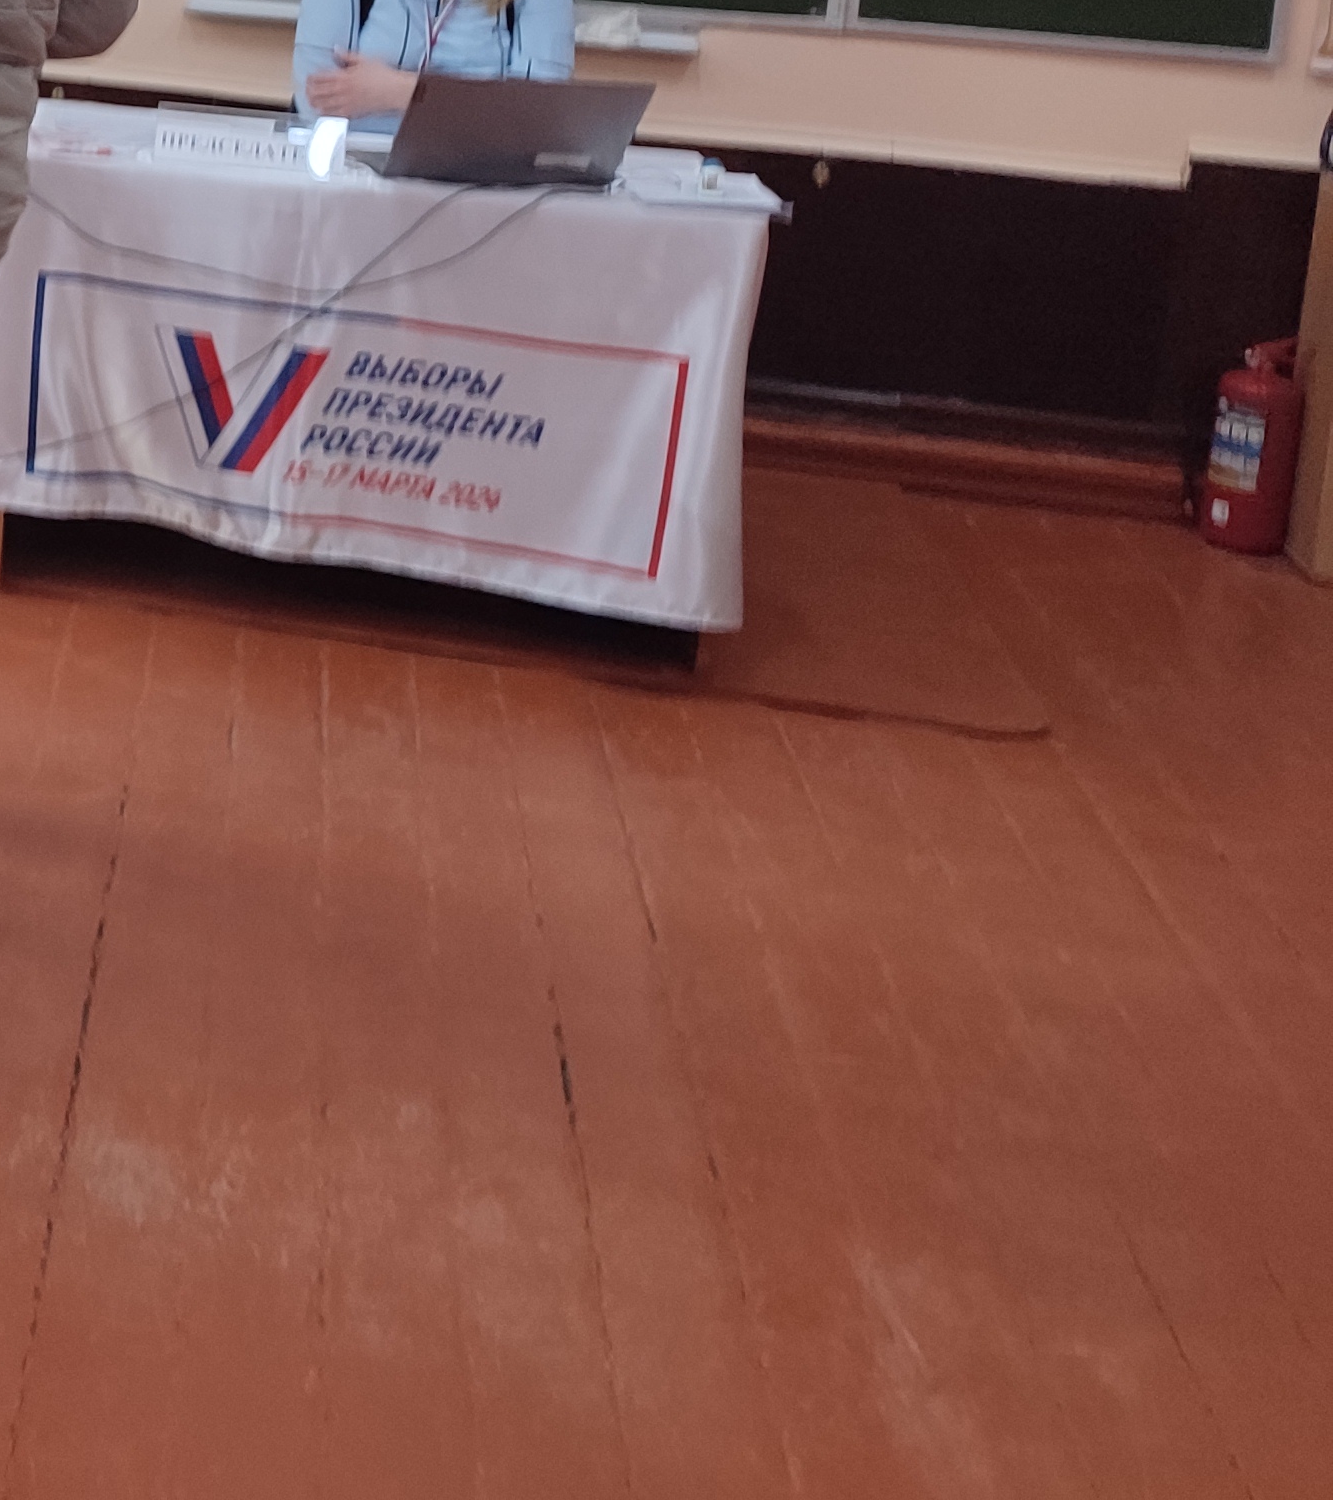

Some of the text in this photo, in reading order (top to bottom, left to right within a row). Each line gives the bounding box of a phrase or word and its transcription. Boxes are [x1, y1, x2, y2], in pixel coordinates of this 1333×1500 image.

[345, 350, 504, 401] ВЫБОРЫ
[321, 386, 546, 449] ПРЕЗИДЕНТА
[300, 423, 443, 468] РОССИИ
[347, 465, 438, 501] МАРТА
[437, 480, 502, 513] 2024
